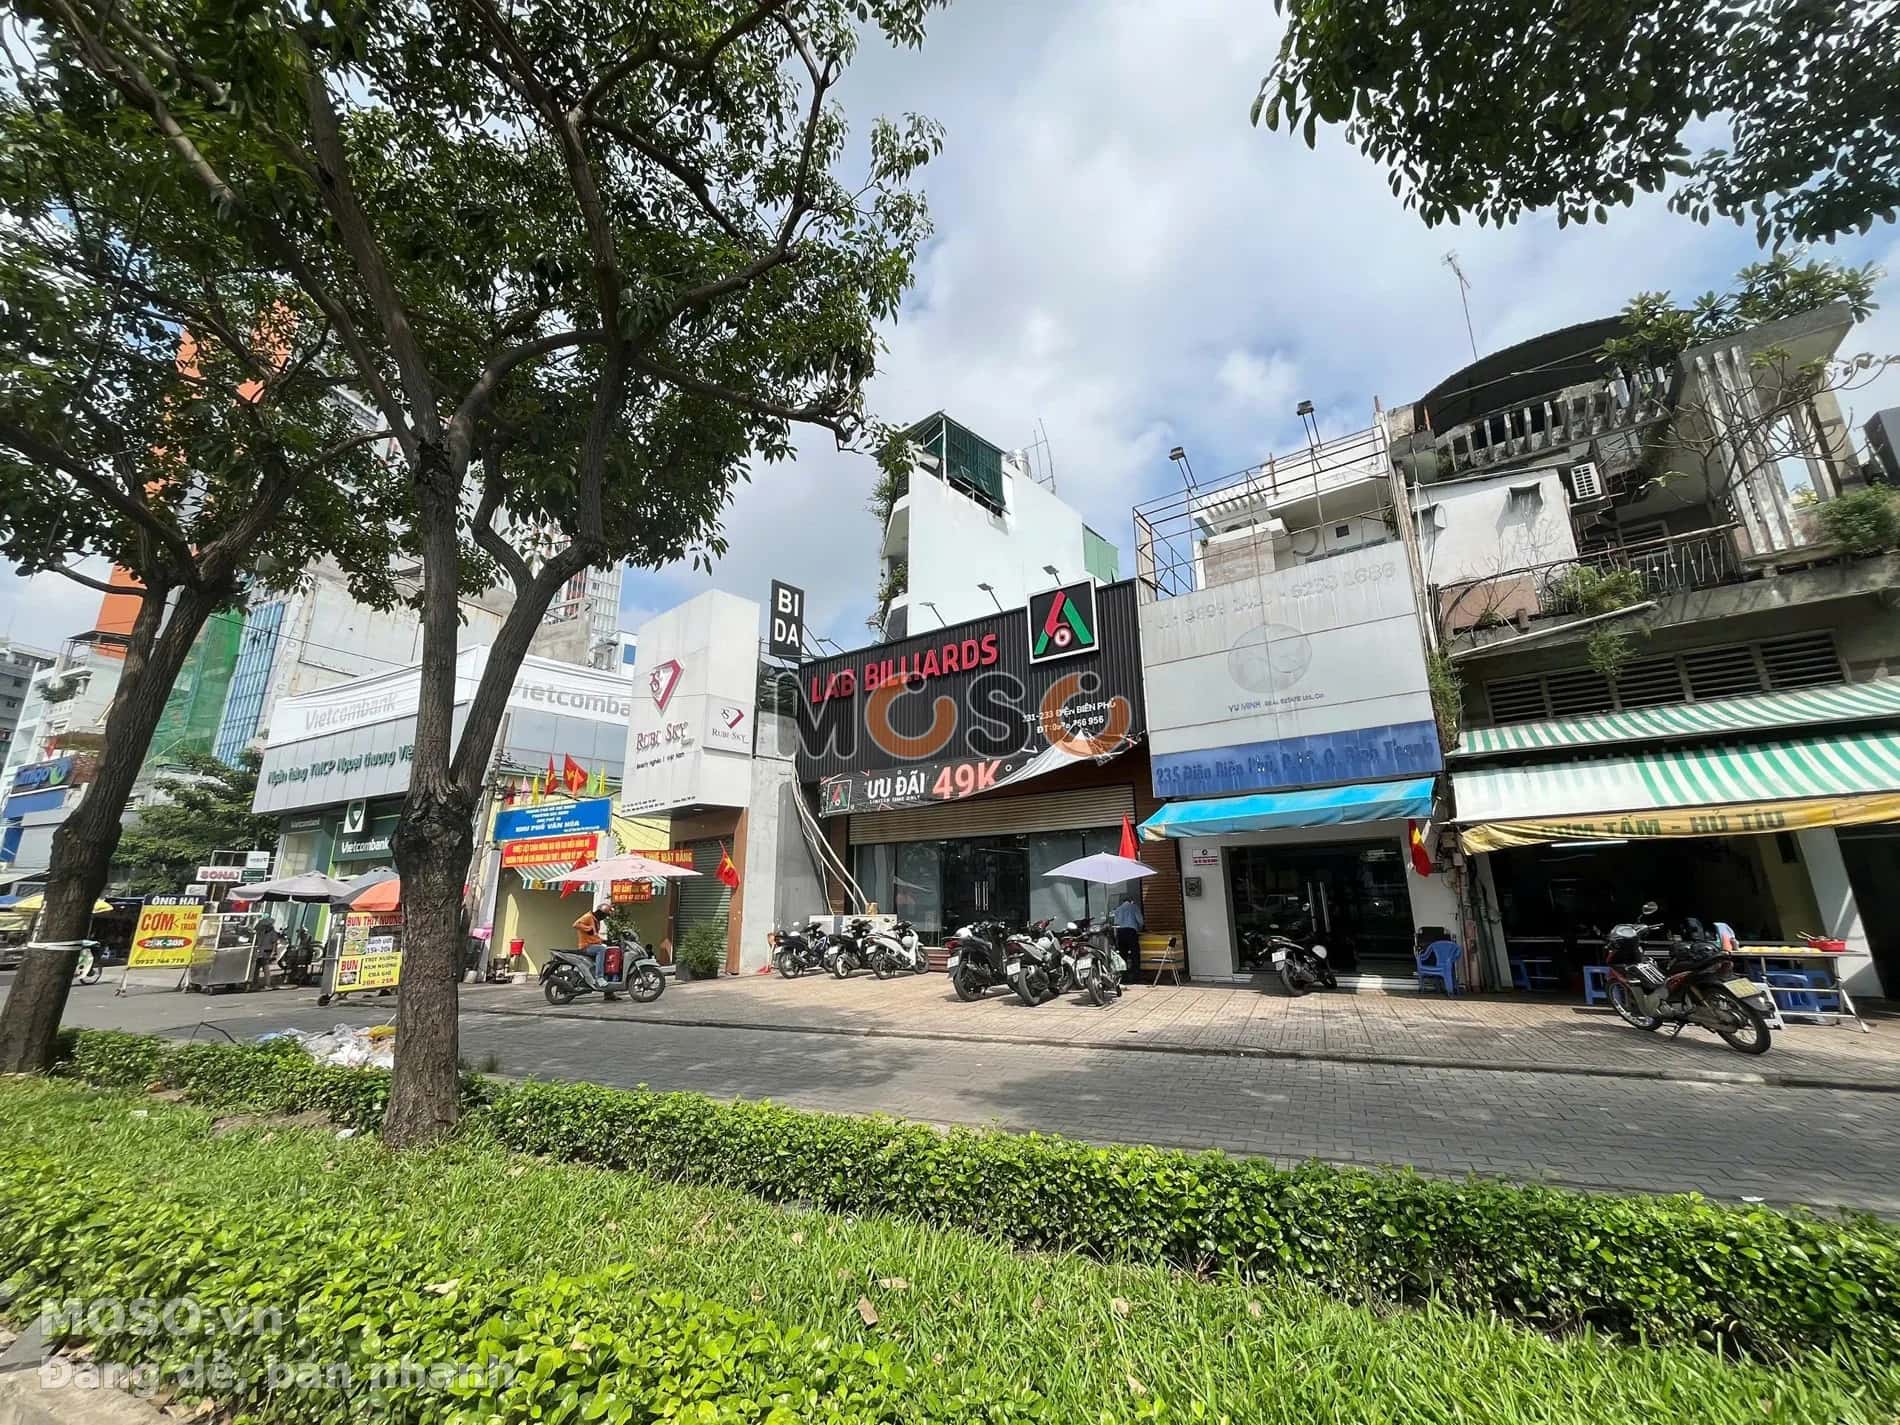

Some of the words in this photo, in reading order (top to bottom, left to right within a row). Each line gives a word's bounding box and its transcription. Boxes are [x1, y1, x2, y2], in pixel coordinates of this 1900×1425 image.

[778, 587, 799, 617] BI
[774, 617, 799, 648] DA
[811, 668, 856, 704] LAB
[864, 632, 998, 692] BILLIARDS
[305, 692, 397, 730] Vietcombank
[512, 678, 630, 717] ietcomba
[310, 760, 336, 777] TMCP
[895, 769, 925, 796] ĐÃI
[931, 759, 1001, 800] 49K
[1157, 766, 1180, 785] 235
[342, 836, 390, 854] Vietcombank
[141, 912, 176, 931] CƠM
